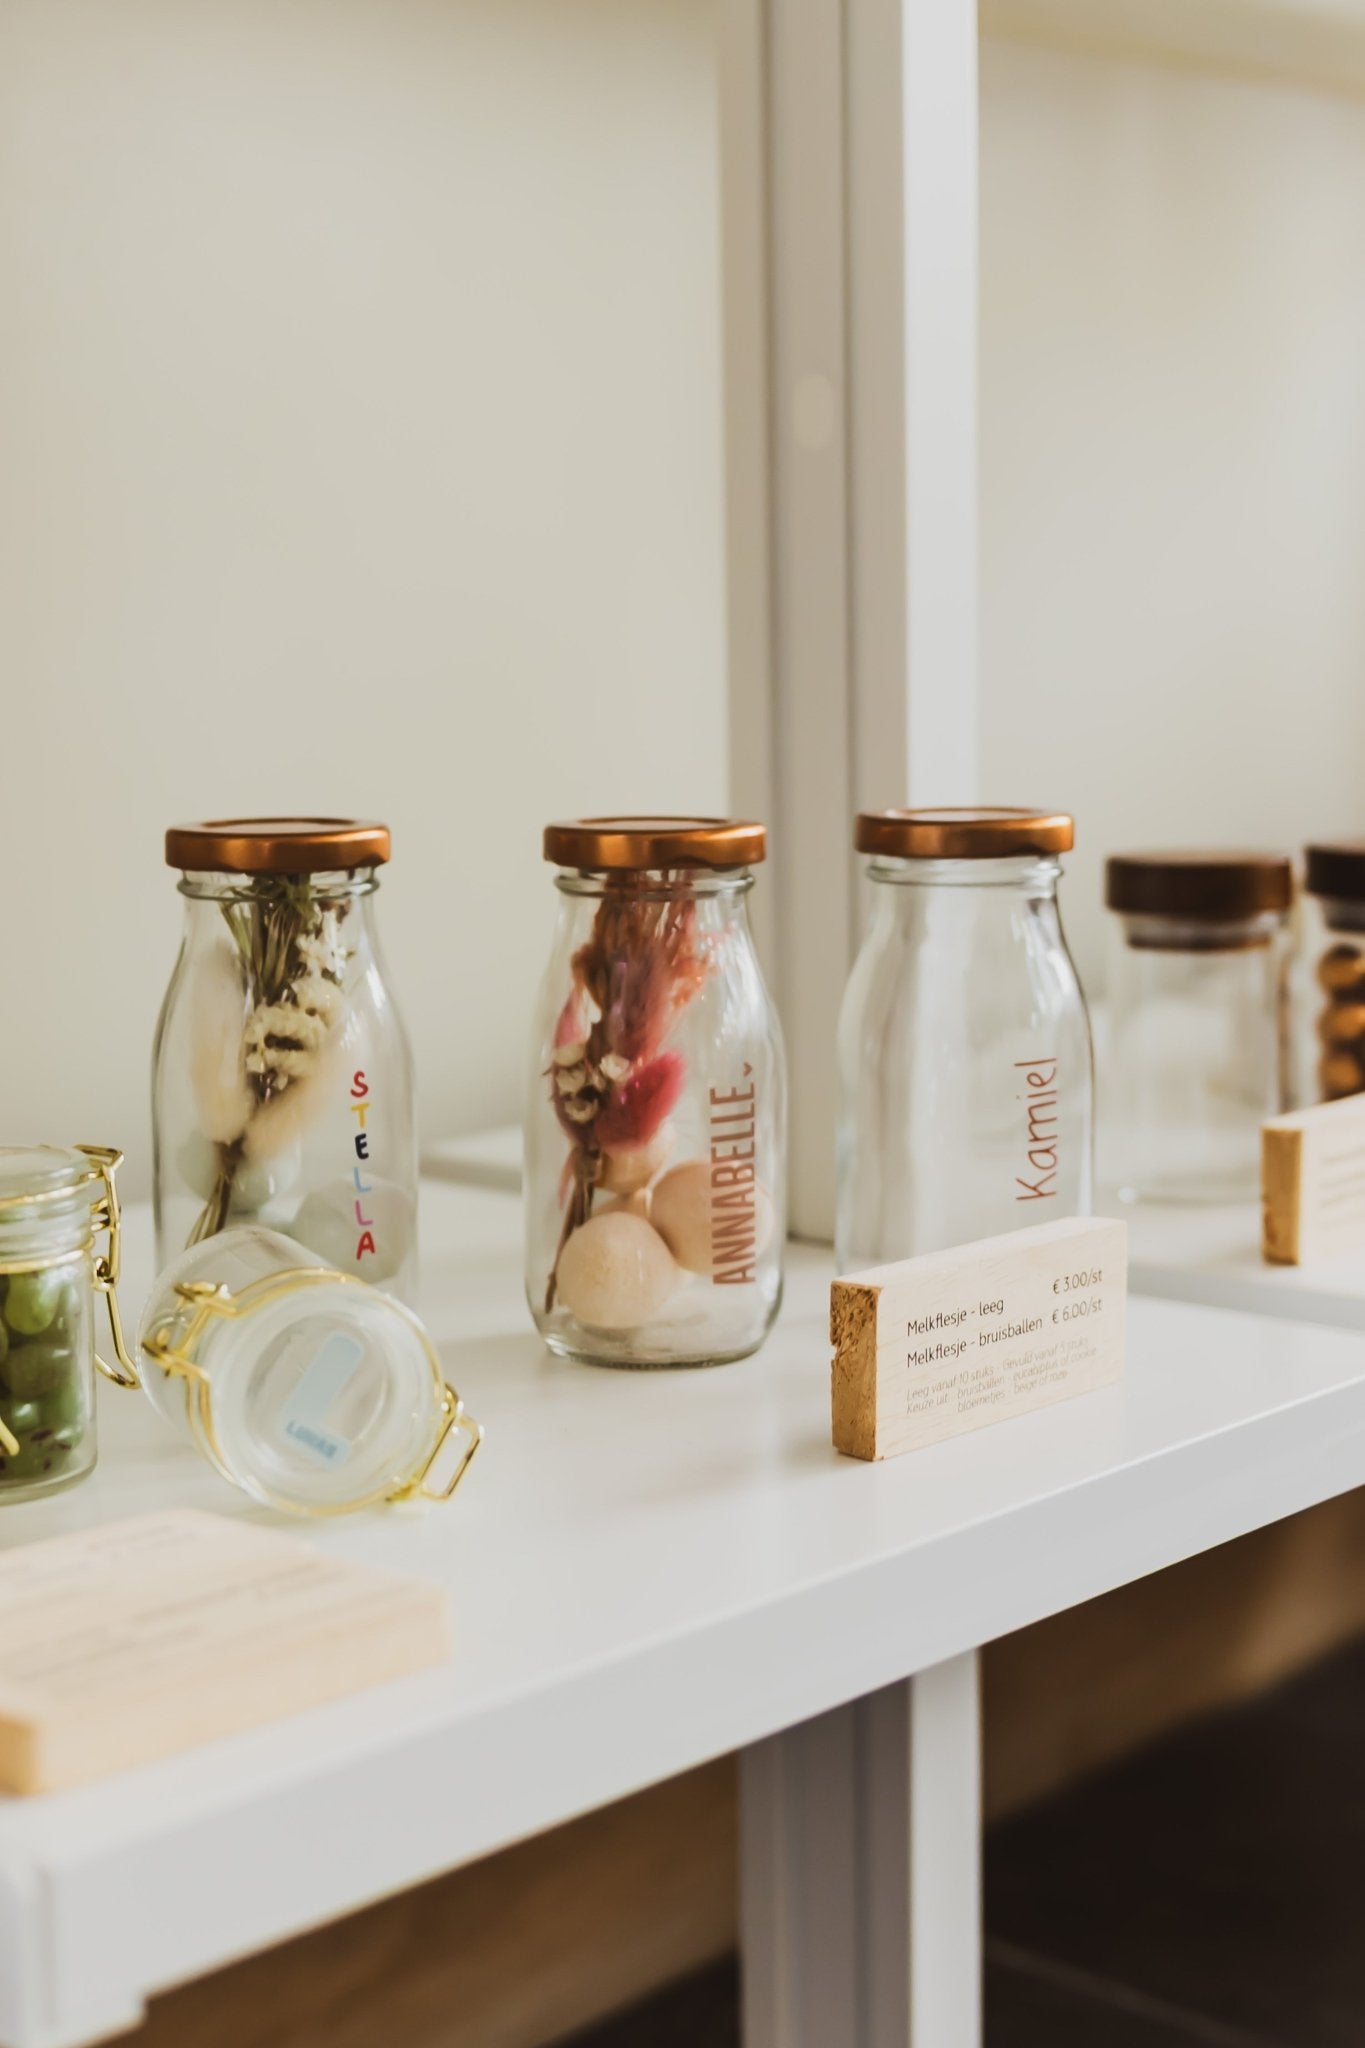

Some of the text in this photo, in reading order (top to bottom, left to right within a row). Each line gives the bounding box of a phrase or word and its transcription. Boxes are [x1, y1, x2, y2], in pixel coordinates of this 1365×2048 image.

[1014, 1057, 1057, 1201] Kamiel
[350, 1070, 375, 1261] STELLA
[710, 1082, 755, 1285] ANNABELLE
[907, 1309, 967, 1337] Melkflesje
[979, 1299, 1004, 1317] leeg
[1053, 1278, 1060, 1295] €
[1063, 1268, 1103, 1292] 3.00/st
[907, 1338, 967, 1369] Melkflesje
[979, 1316, 1042, 1347] bruisballen
[1052, 1308, 1059, 1325] €
[1062, 1297, 1102, 1321] 6.00/st
[907, 1386, 930, 1402] Leeg
[932, 1373, 957, 1393] vanaf
[960, 1371, 969, 1386] 10
[971, 1366, 995, 1381] stuks
[907, 1399, 933, 1415] Keuze
[957, 1375, 1005, 1400] bruisballen
[957, 1388, 1006, 1413] bloemetjes
